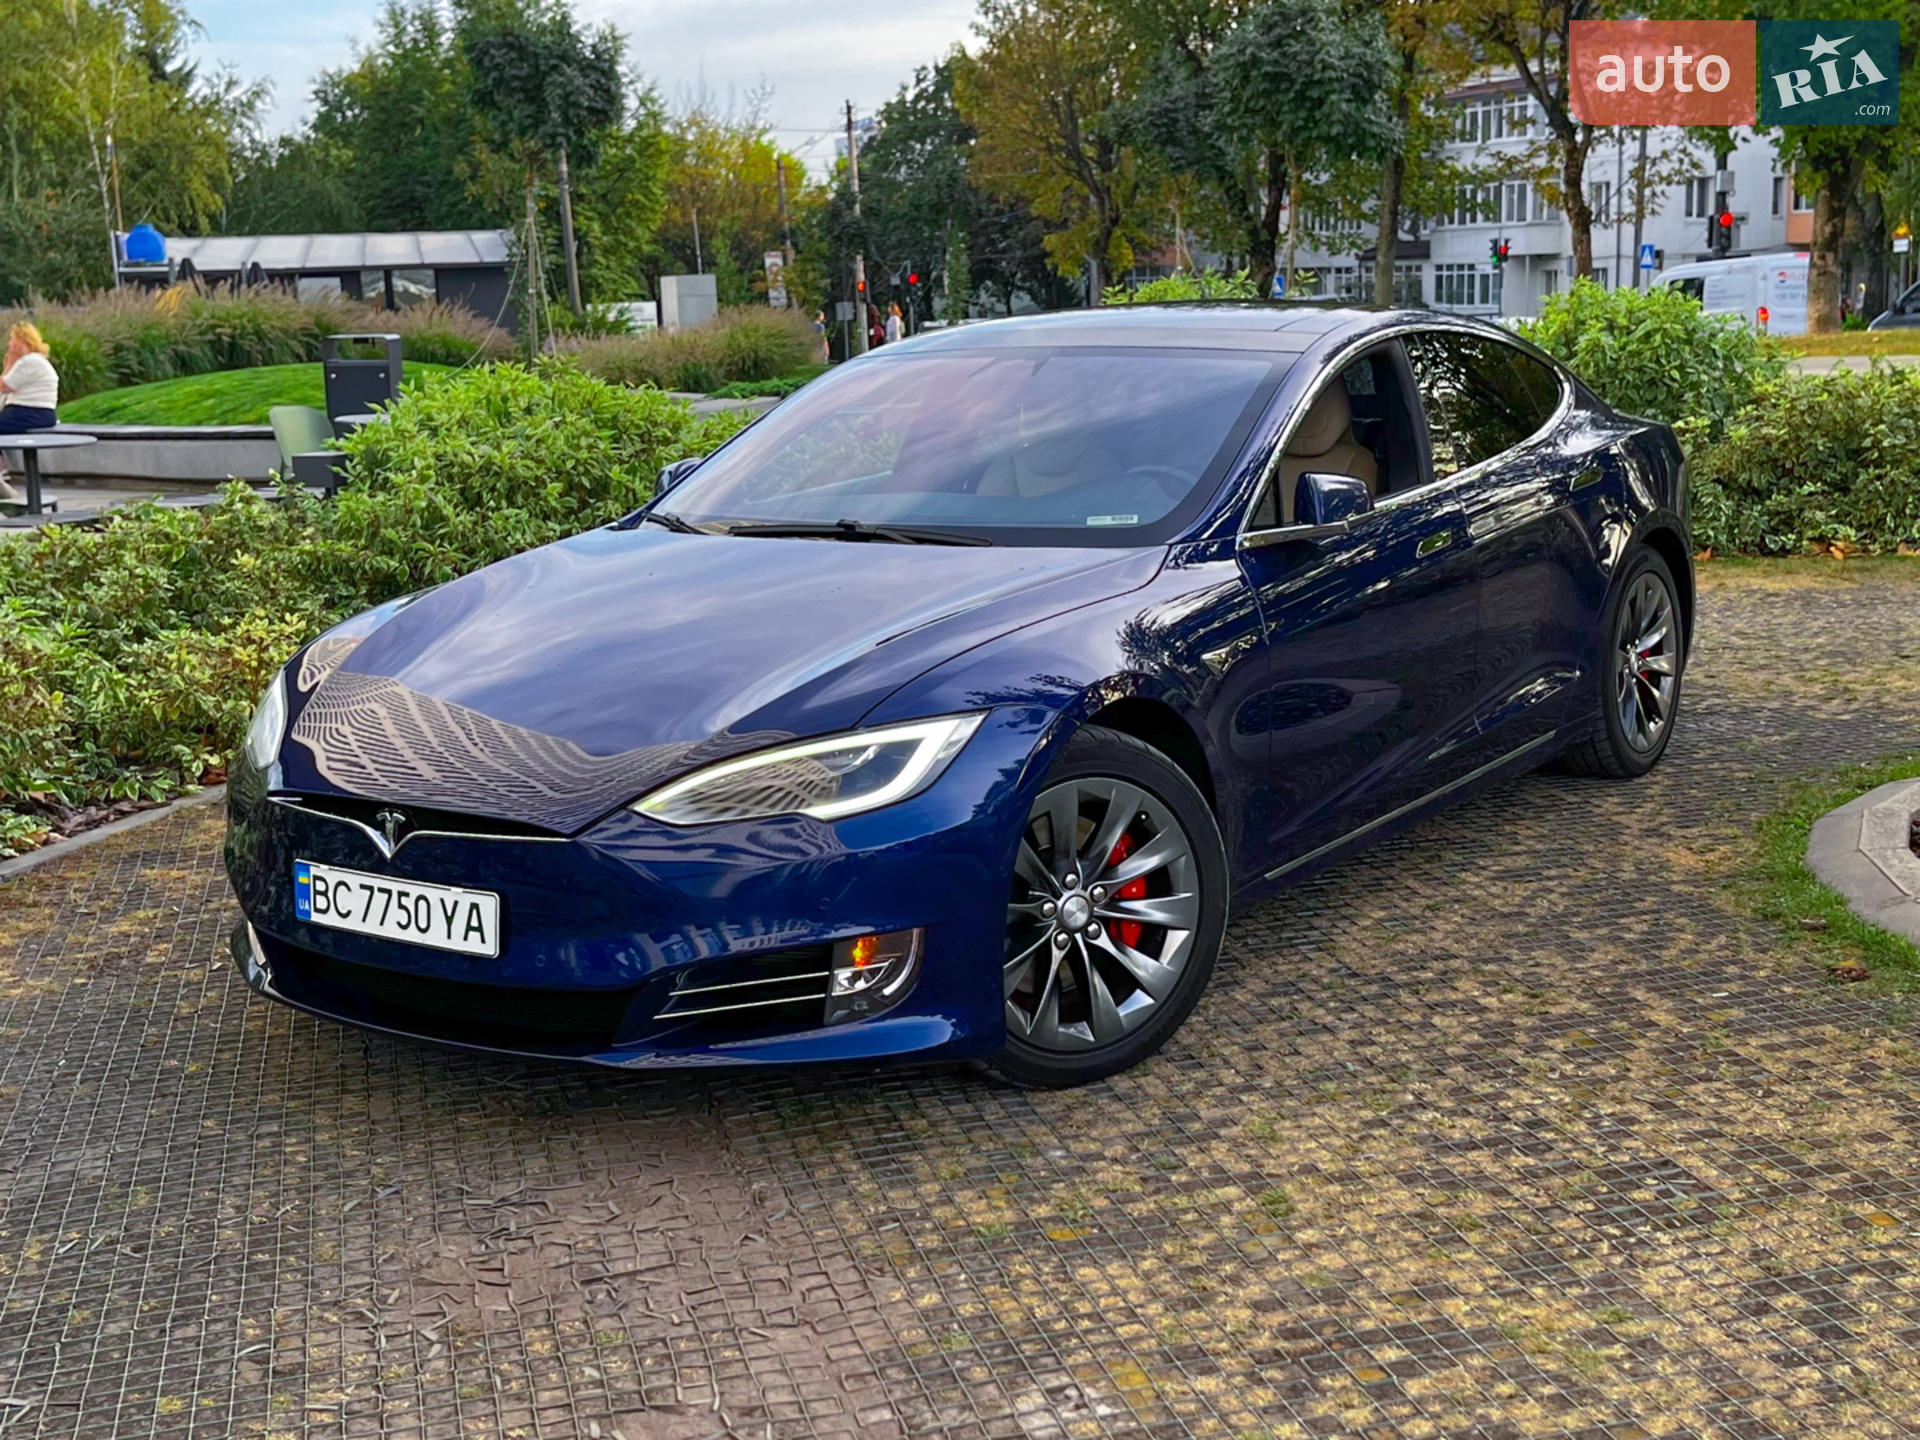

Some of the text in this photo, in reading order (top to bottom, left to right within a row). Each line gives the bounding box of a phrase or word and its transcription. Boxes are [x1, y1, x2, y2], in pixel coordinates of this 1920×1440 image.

[299, 897, 310, 911] UA
[312, 873, 487, 945] BC 7750 YA
